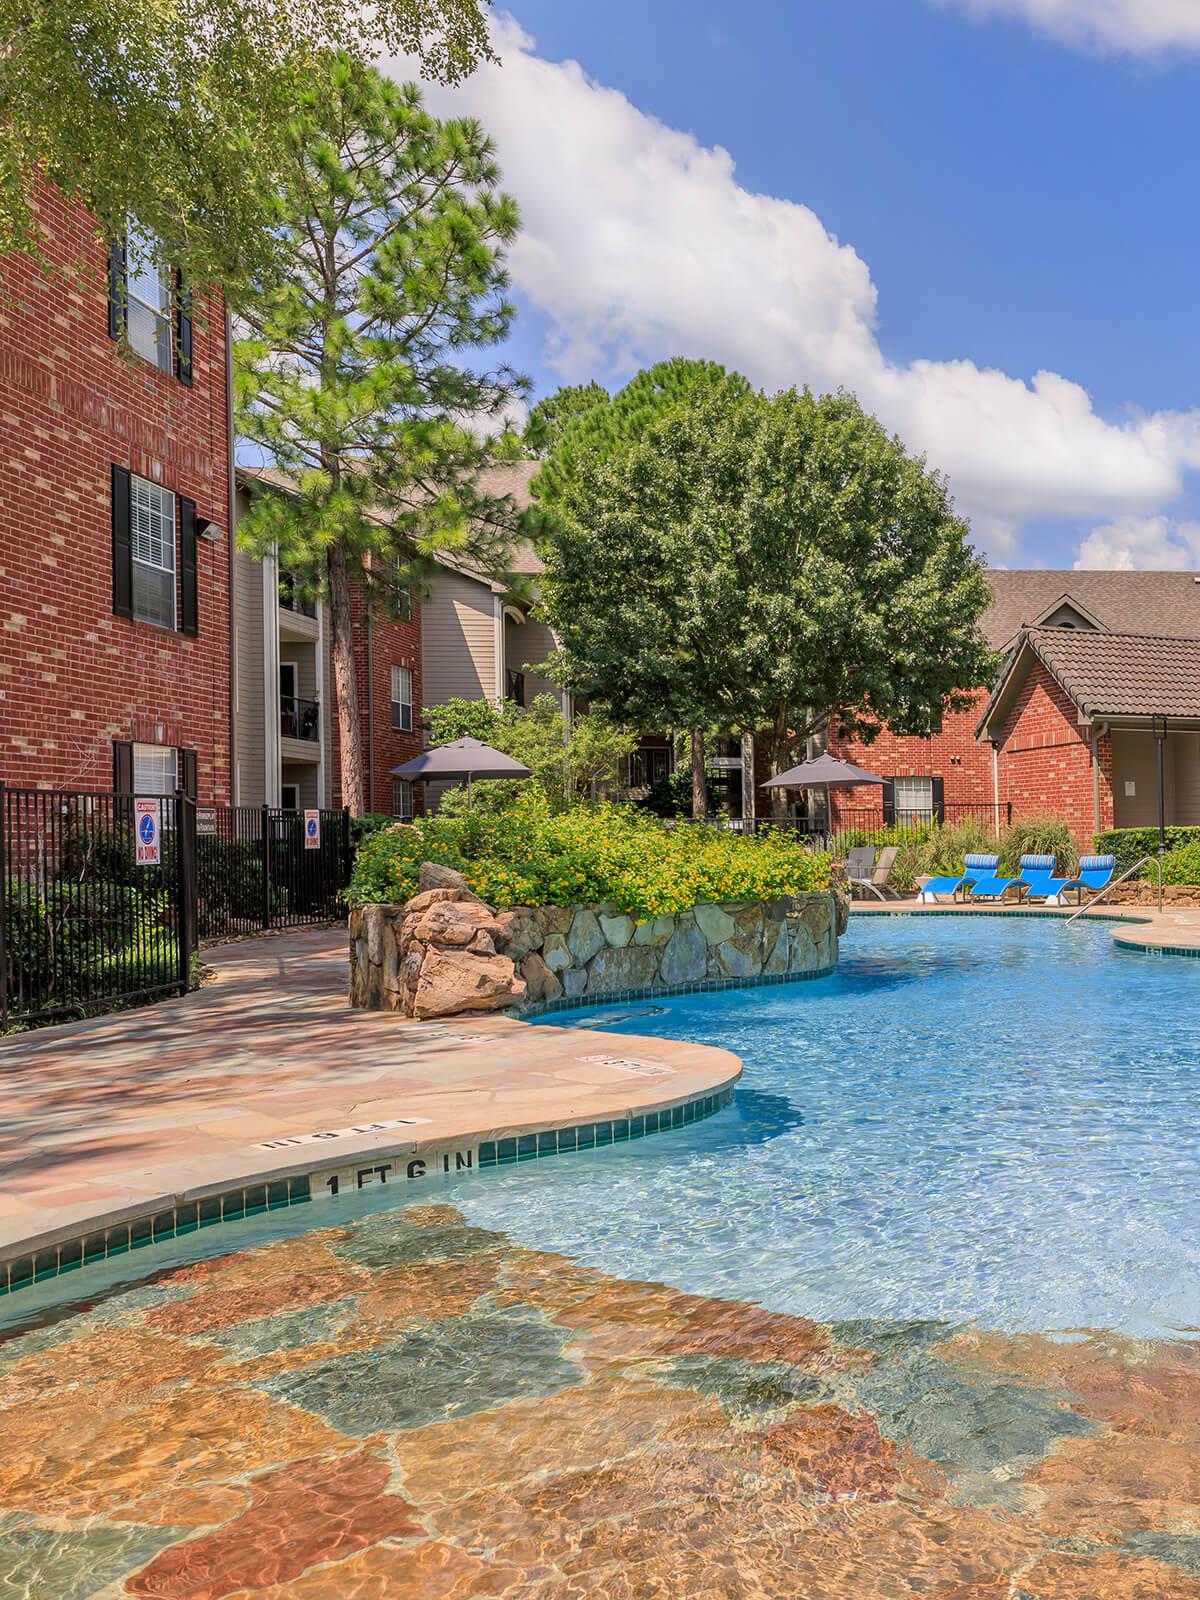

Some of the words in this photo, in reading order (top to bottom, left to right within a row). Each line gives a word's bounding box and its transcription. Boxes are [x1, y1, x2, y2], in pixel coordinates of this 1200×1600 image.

[326, 1175, 339, 1195] 1
[357, 1164, 392, 1189] FT
[443, 1150, 473, 1173] IN
